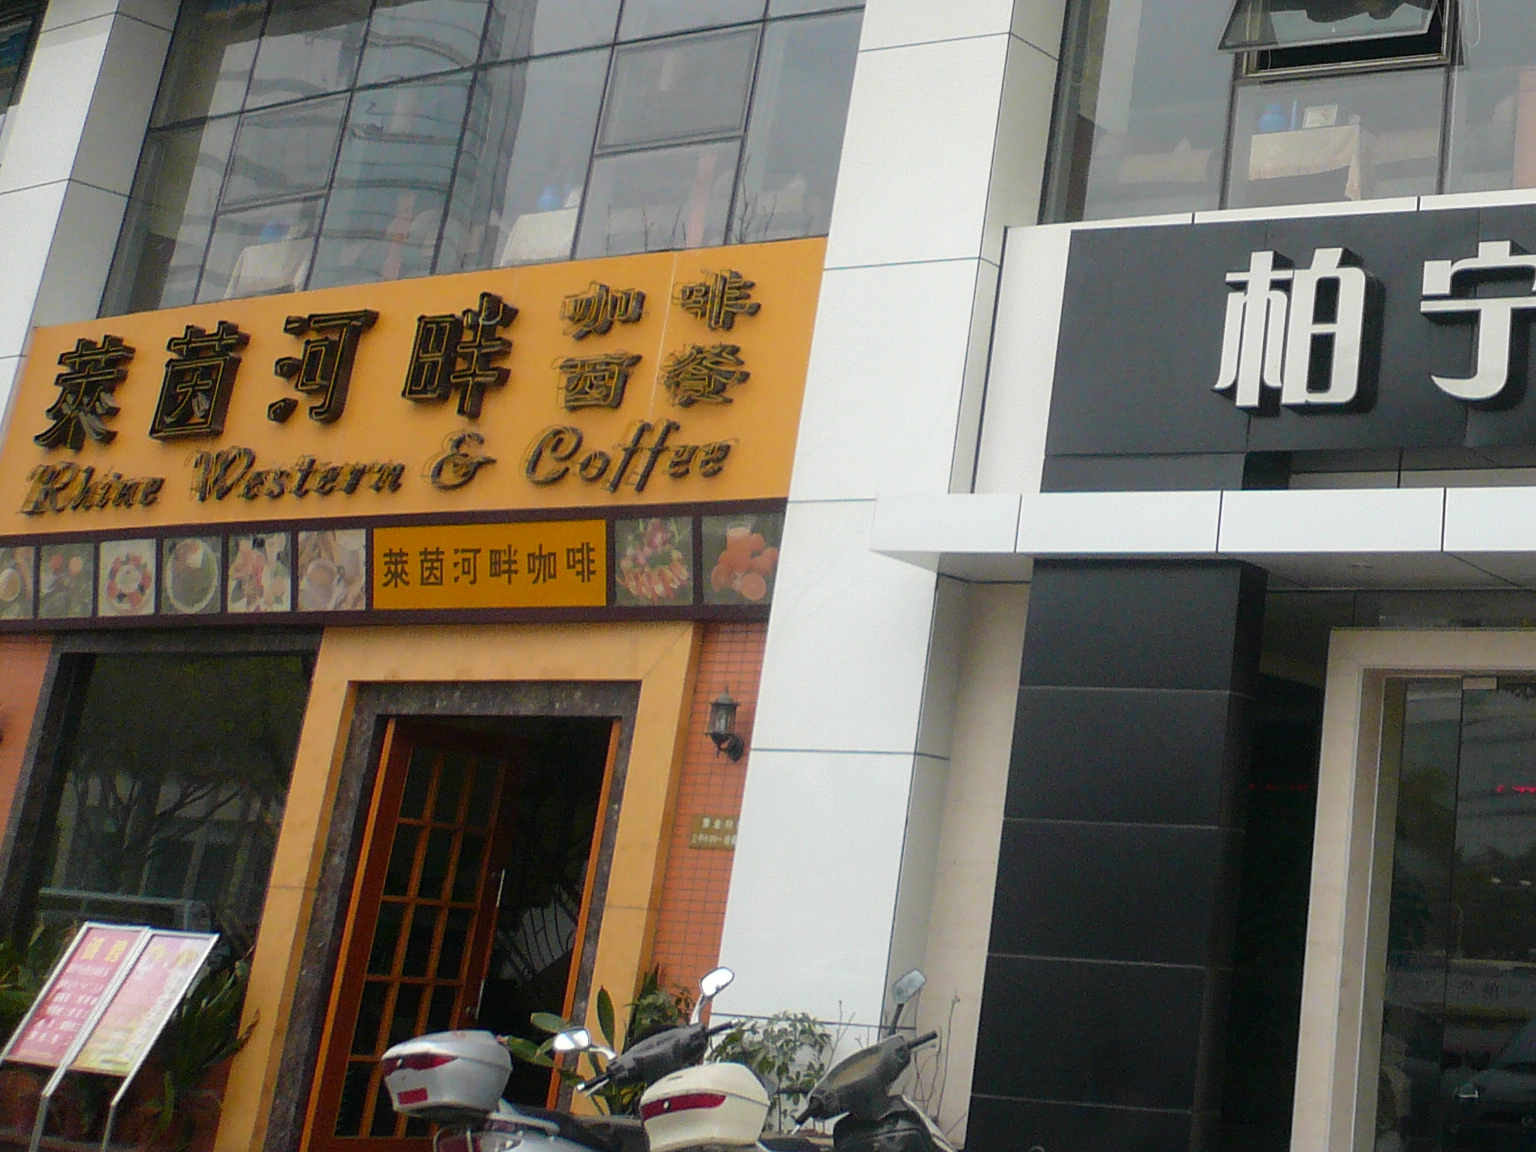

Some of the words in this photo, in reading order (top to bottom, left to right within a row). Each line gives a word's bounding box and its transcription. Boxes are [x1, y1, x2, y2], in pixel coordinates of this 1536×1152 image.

[15, 460, 166, 517] Rhine
[184, 446, 407, 503] Western
[422, 429, 498, 491] &
[519, 416, 739, 494] Coffee
